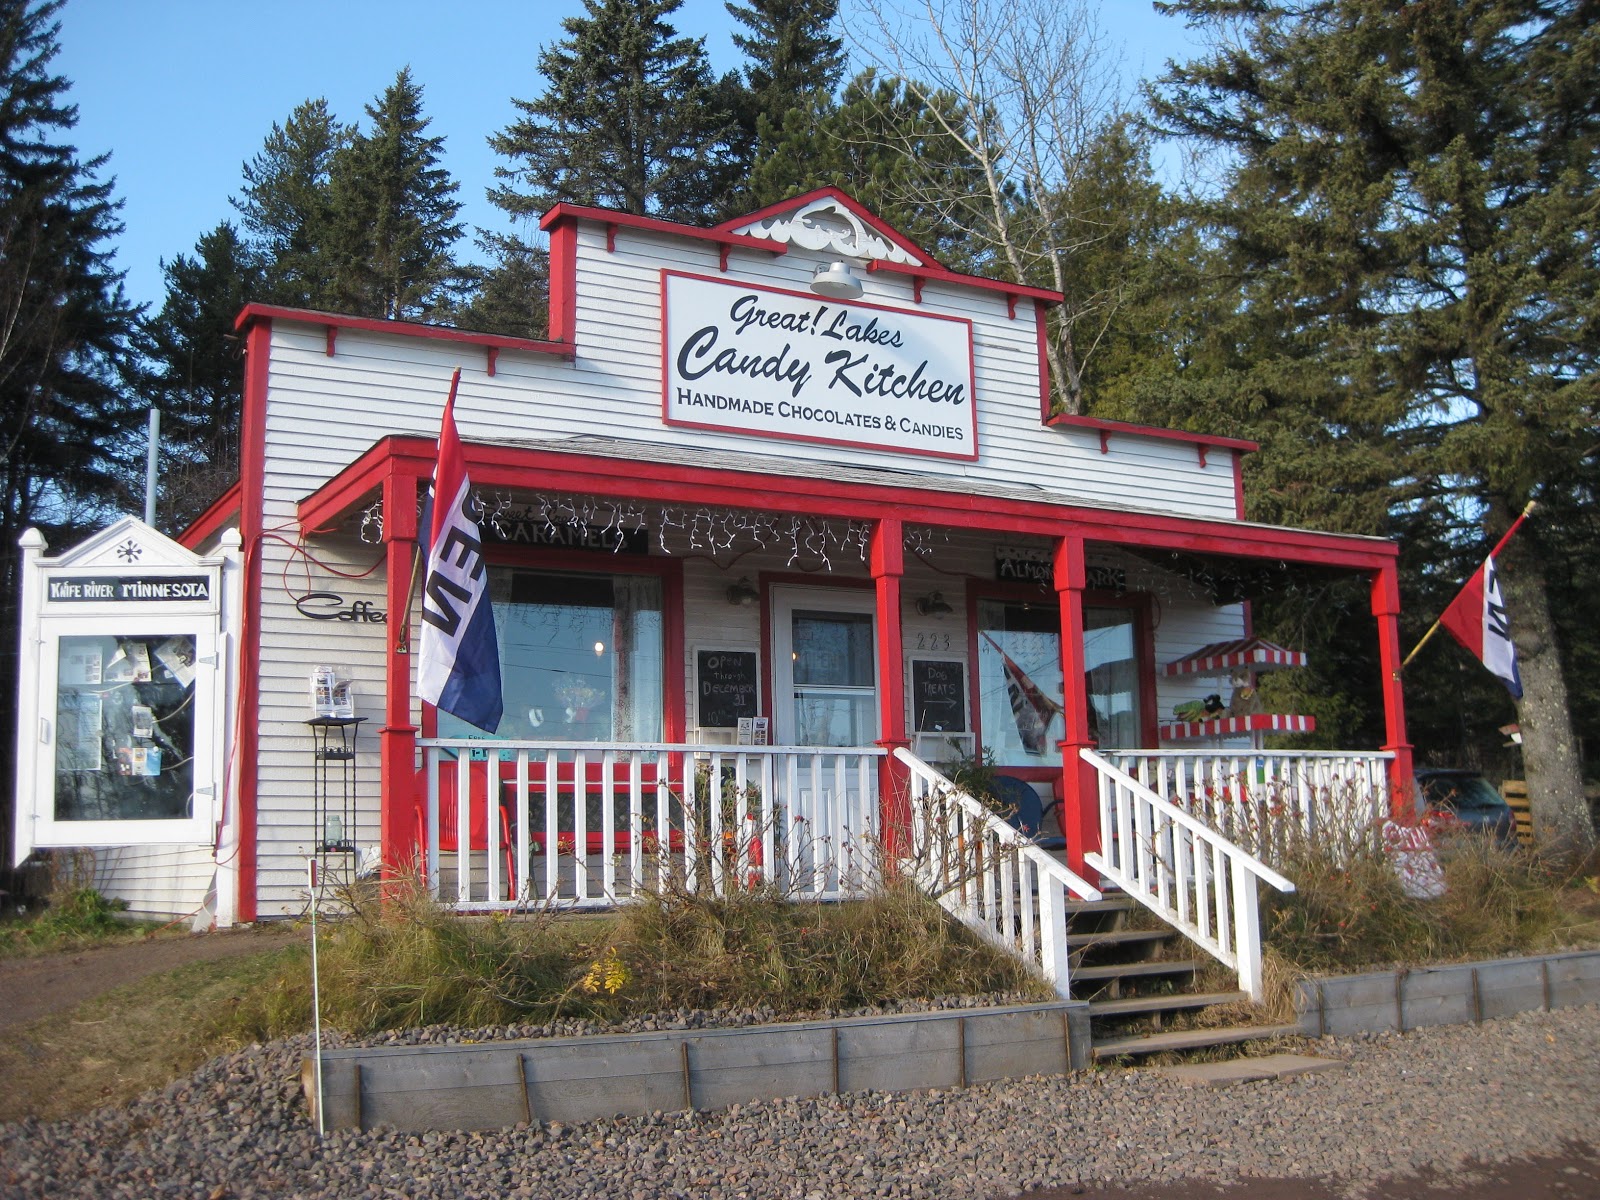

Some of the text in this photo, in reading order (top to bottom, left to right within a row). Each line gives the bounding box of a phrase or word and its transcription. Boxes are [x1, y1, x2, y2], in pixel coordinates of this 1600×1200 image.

[730, 295, 903, 348] Great! Lakes
[677, 325, 965, 405] Candy Kitchen
[677, 388, 963, 441] HANDMADE CHOCOLATES & CANDIES
[495, 520, 628, 550] CARAMELS
[917, 632, 950, 651] 223
